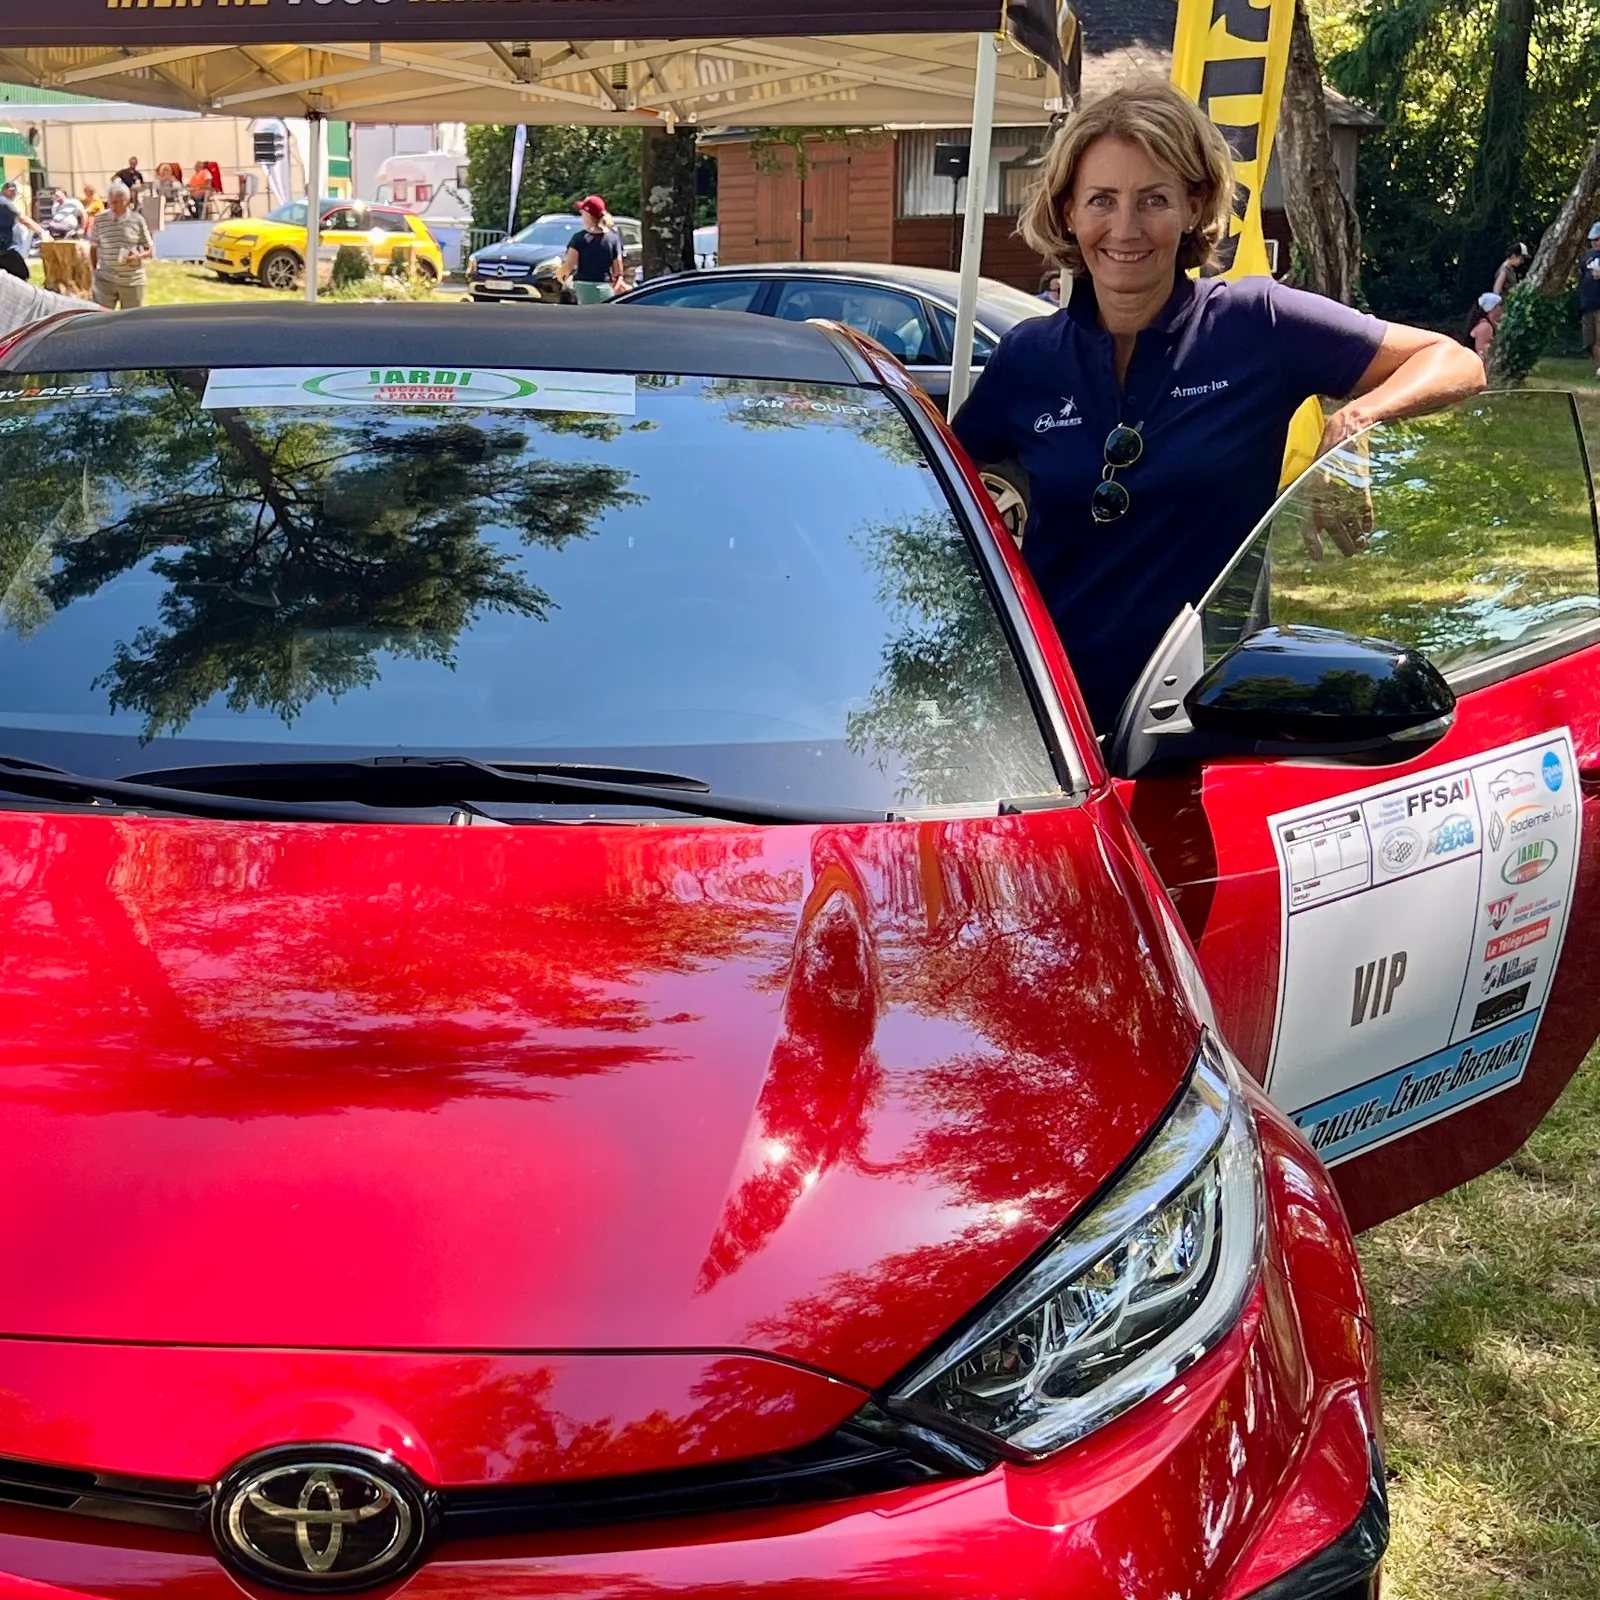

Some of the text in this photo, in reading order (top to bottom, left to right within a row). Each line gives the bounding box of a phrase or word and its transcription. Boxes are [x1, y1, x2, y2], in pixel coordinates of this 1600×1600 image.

[368, 370, 473, 386] JARDI
[380, 385, 455, 393] LOCATION
[389, 392, 456, 402] PAYSAGE
[1170, 379, 1229, 398] Armor-lux
[743, 398, 785, 408] CAR
[810, 402, 871, 416] OUEST
[1406, 780, 1464, 817] FFSA
[1516, 840, 1544, 866] JARDI
[1490, 900, 1511, 921] AD
[1486, 925, 1548, 958] Le Télégramme
[1350, 950, 1408, 1027] VIP
